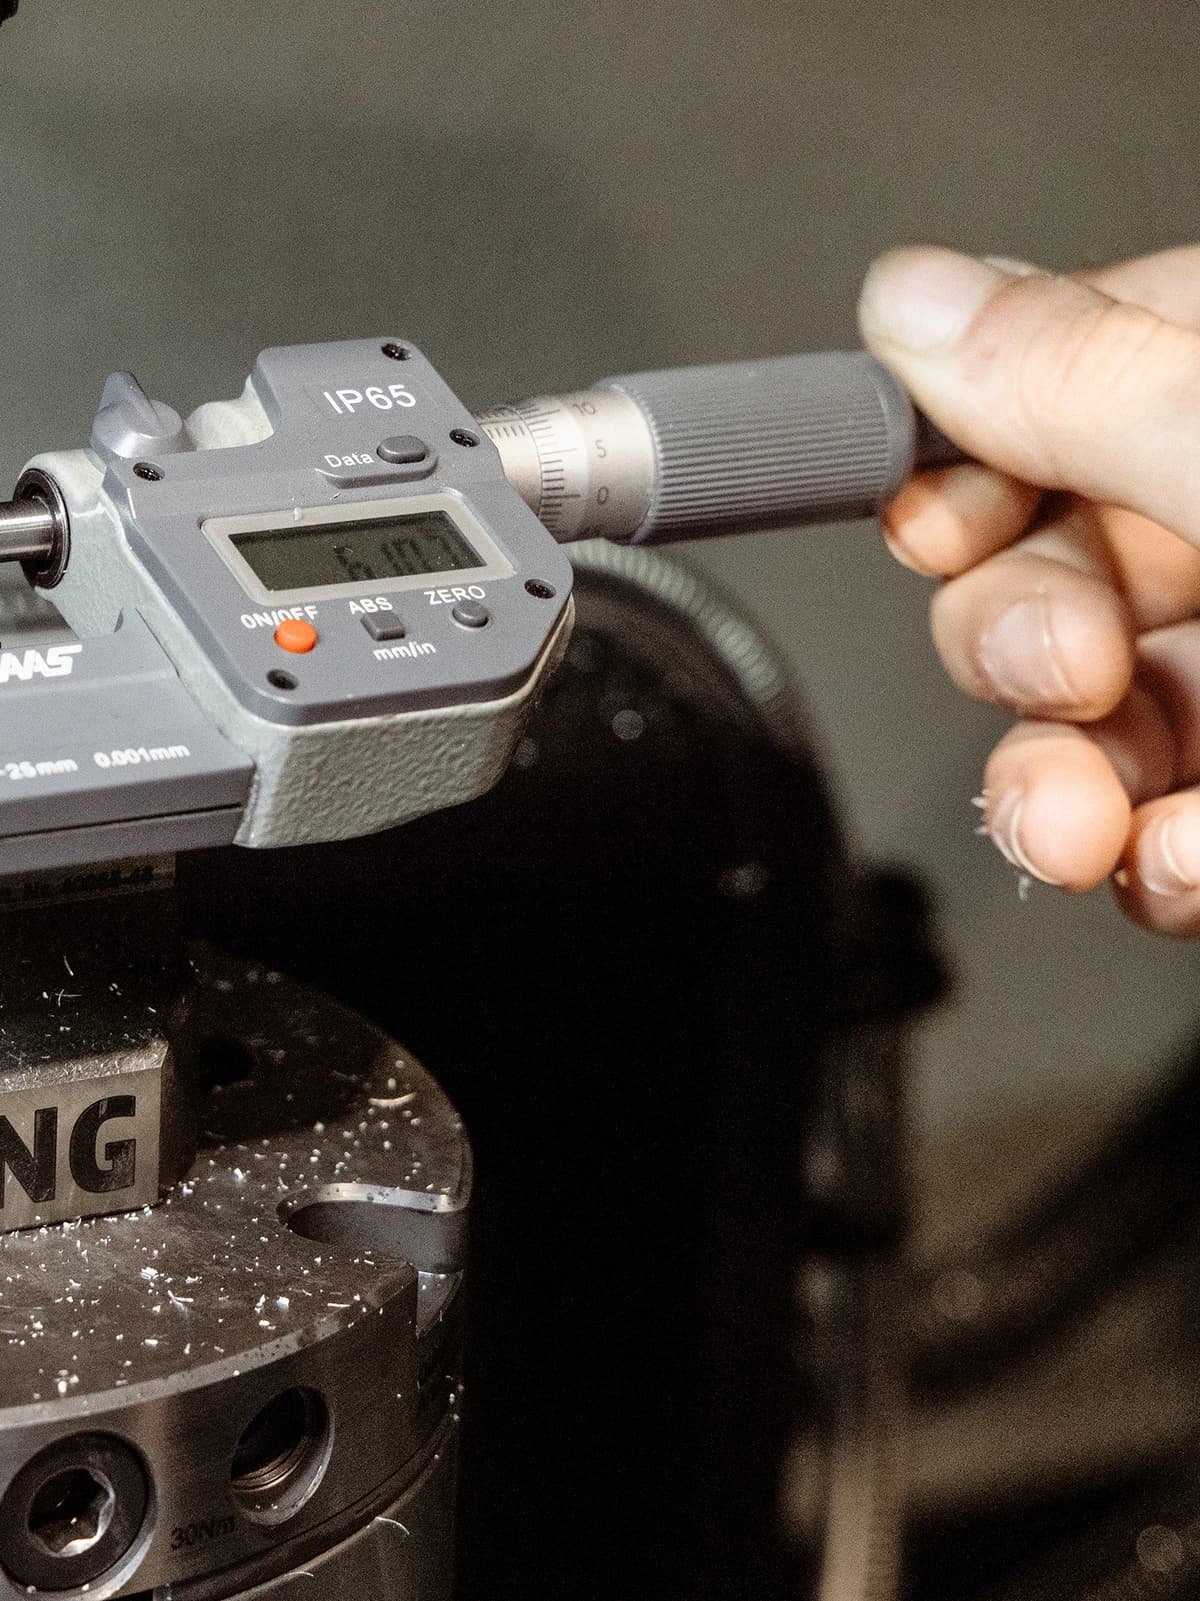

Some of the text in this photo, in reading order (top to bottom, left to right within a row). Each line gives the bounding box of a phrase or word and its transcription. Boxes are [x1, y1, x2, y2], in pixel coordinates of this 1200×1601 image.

[323, 383, 417, 415] IP65
[595, 439, 607, 459] 5
[324, 451, 374, 469] Data
[596, 486, 609, 505] 0
[348, 597, 393, 615] ABS
[424, 585, 487, 606] ZERO
[240, 605, 318, 629] ON/OFF
[373, 640, 436, 662] mm/in
[93, 745, 190, 768] 0.001mm
